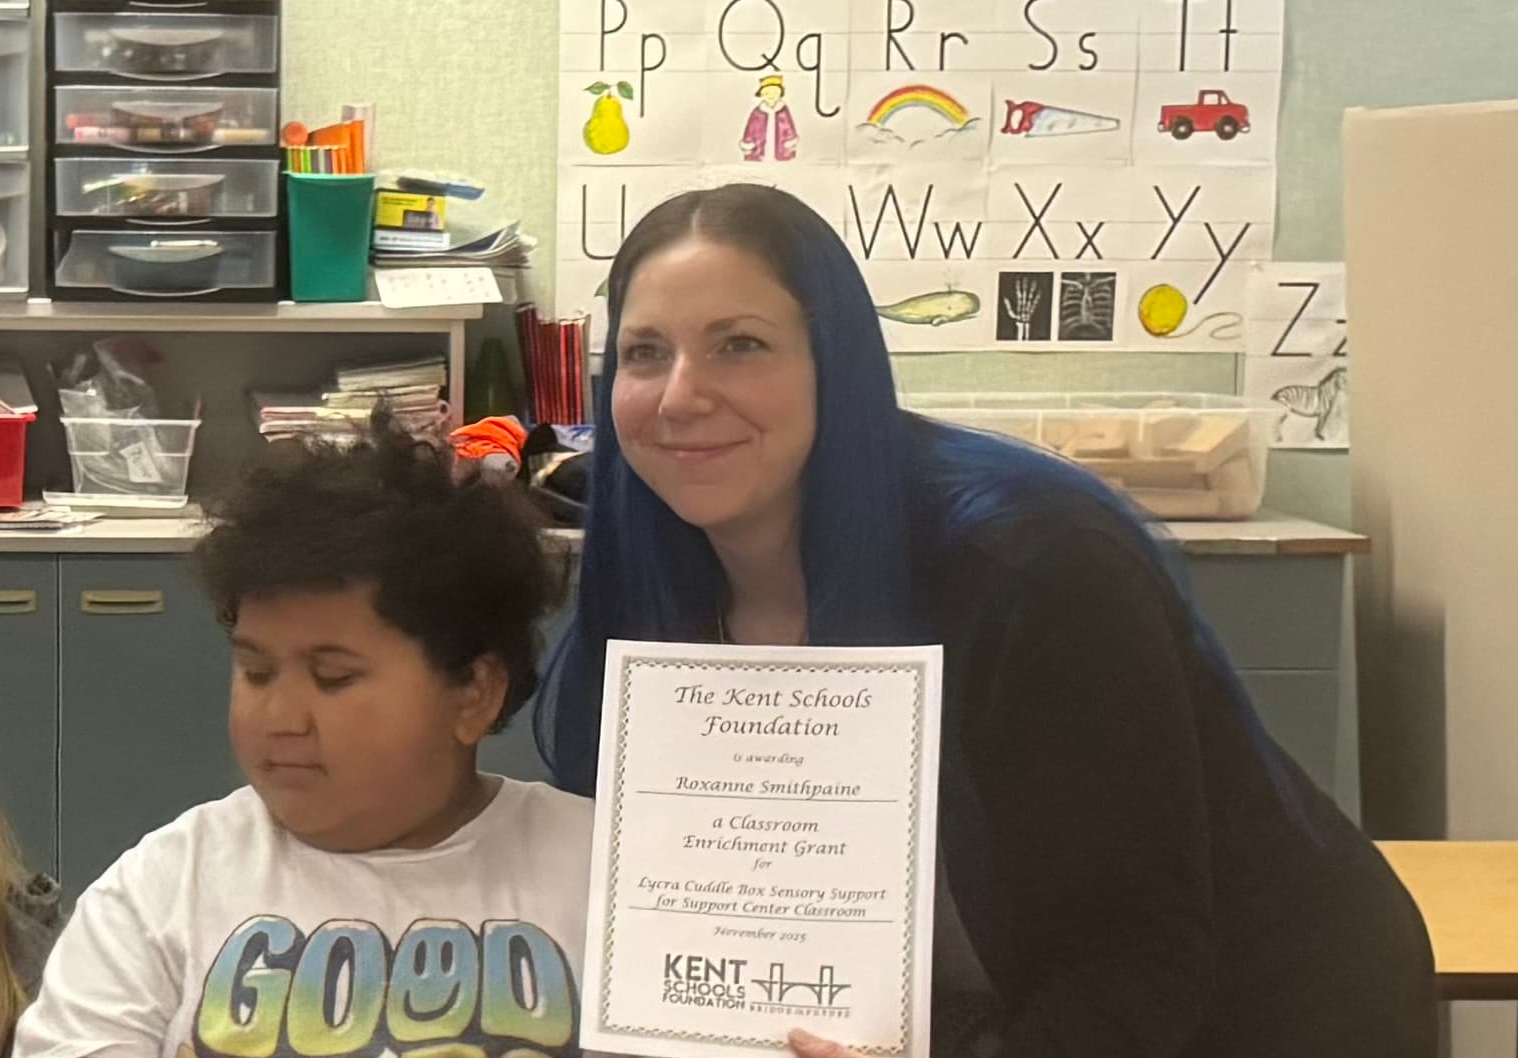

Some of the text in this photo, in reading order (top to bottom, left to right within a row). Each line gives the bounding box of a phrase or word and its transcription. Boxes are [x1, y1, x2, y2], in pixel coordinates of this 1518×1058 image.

[718, 0, 841, 118] Qq
[885, 0, 969, 71] Rr
[1024, 0, 1098, 71] Ss
[848, 184, 983, 260] Ww
[1012, 183, 1105, 260] Xx
[1151, 185, 1252, 305] Yy
[674, 685, 873, 708] The Kent Schools
[701, 715, 840, 736] Foundation
[733, 752, 805, 767] is awarding
[676, 777, 861, 799] Roxanne Smithpaine
[712, 815, 819, 833] a Classroom
[683, 835, 847, 857] Enrichment Grant
[752, 857, 772, 872] for
[637, 876, 887, 903] Lycra Cuddle Box Sensory Support
[656, 895, 866, 918] for Support Center Classroom
[713, 926, 776, 941] November
[664, 953, 748, 984] KENT
[195, 914, 579, 1058] GOOD
[663, 979, 746, 999] SCHOOLS
[662, 993, 746, 1010] FOUNDATION
